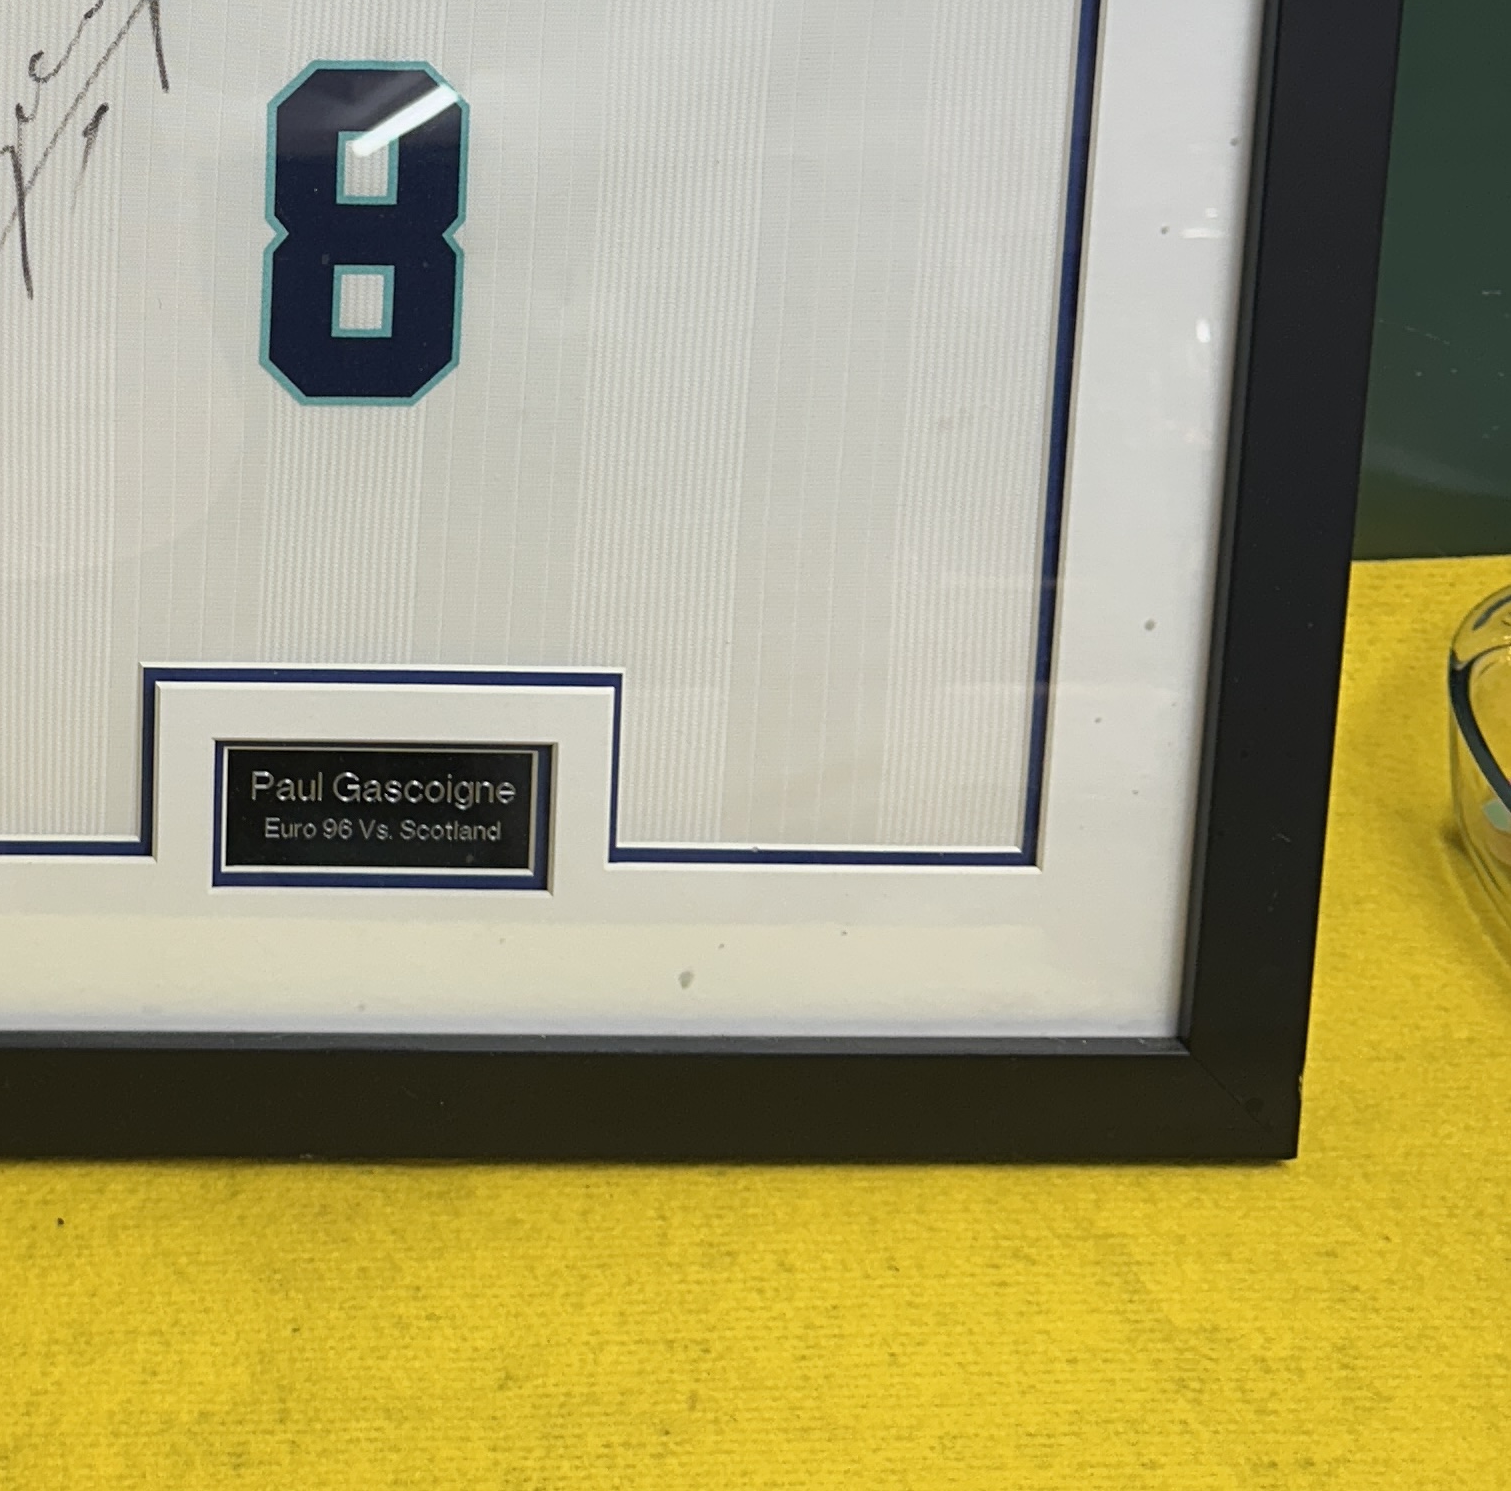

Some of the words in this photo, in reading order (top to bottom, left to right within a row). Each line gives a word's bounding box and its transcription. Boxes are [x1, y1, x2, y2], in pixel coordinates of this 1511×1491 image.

[258, 59, 471, 407] 8
[250, 770, 324, 802] Paul
[332, 772, 517, 811] Gascoigne
[264, 817, 317, 840] Euro
[322, 818, 353, 840] 96
[358, 820, 393, 840] Vs.
[399, 820, 502, 842] Scotland
